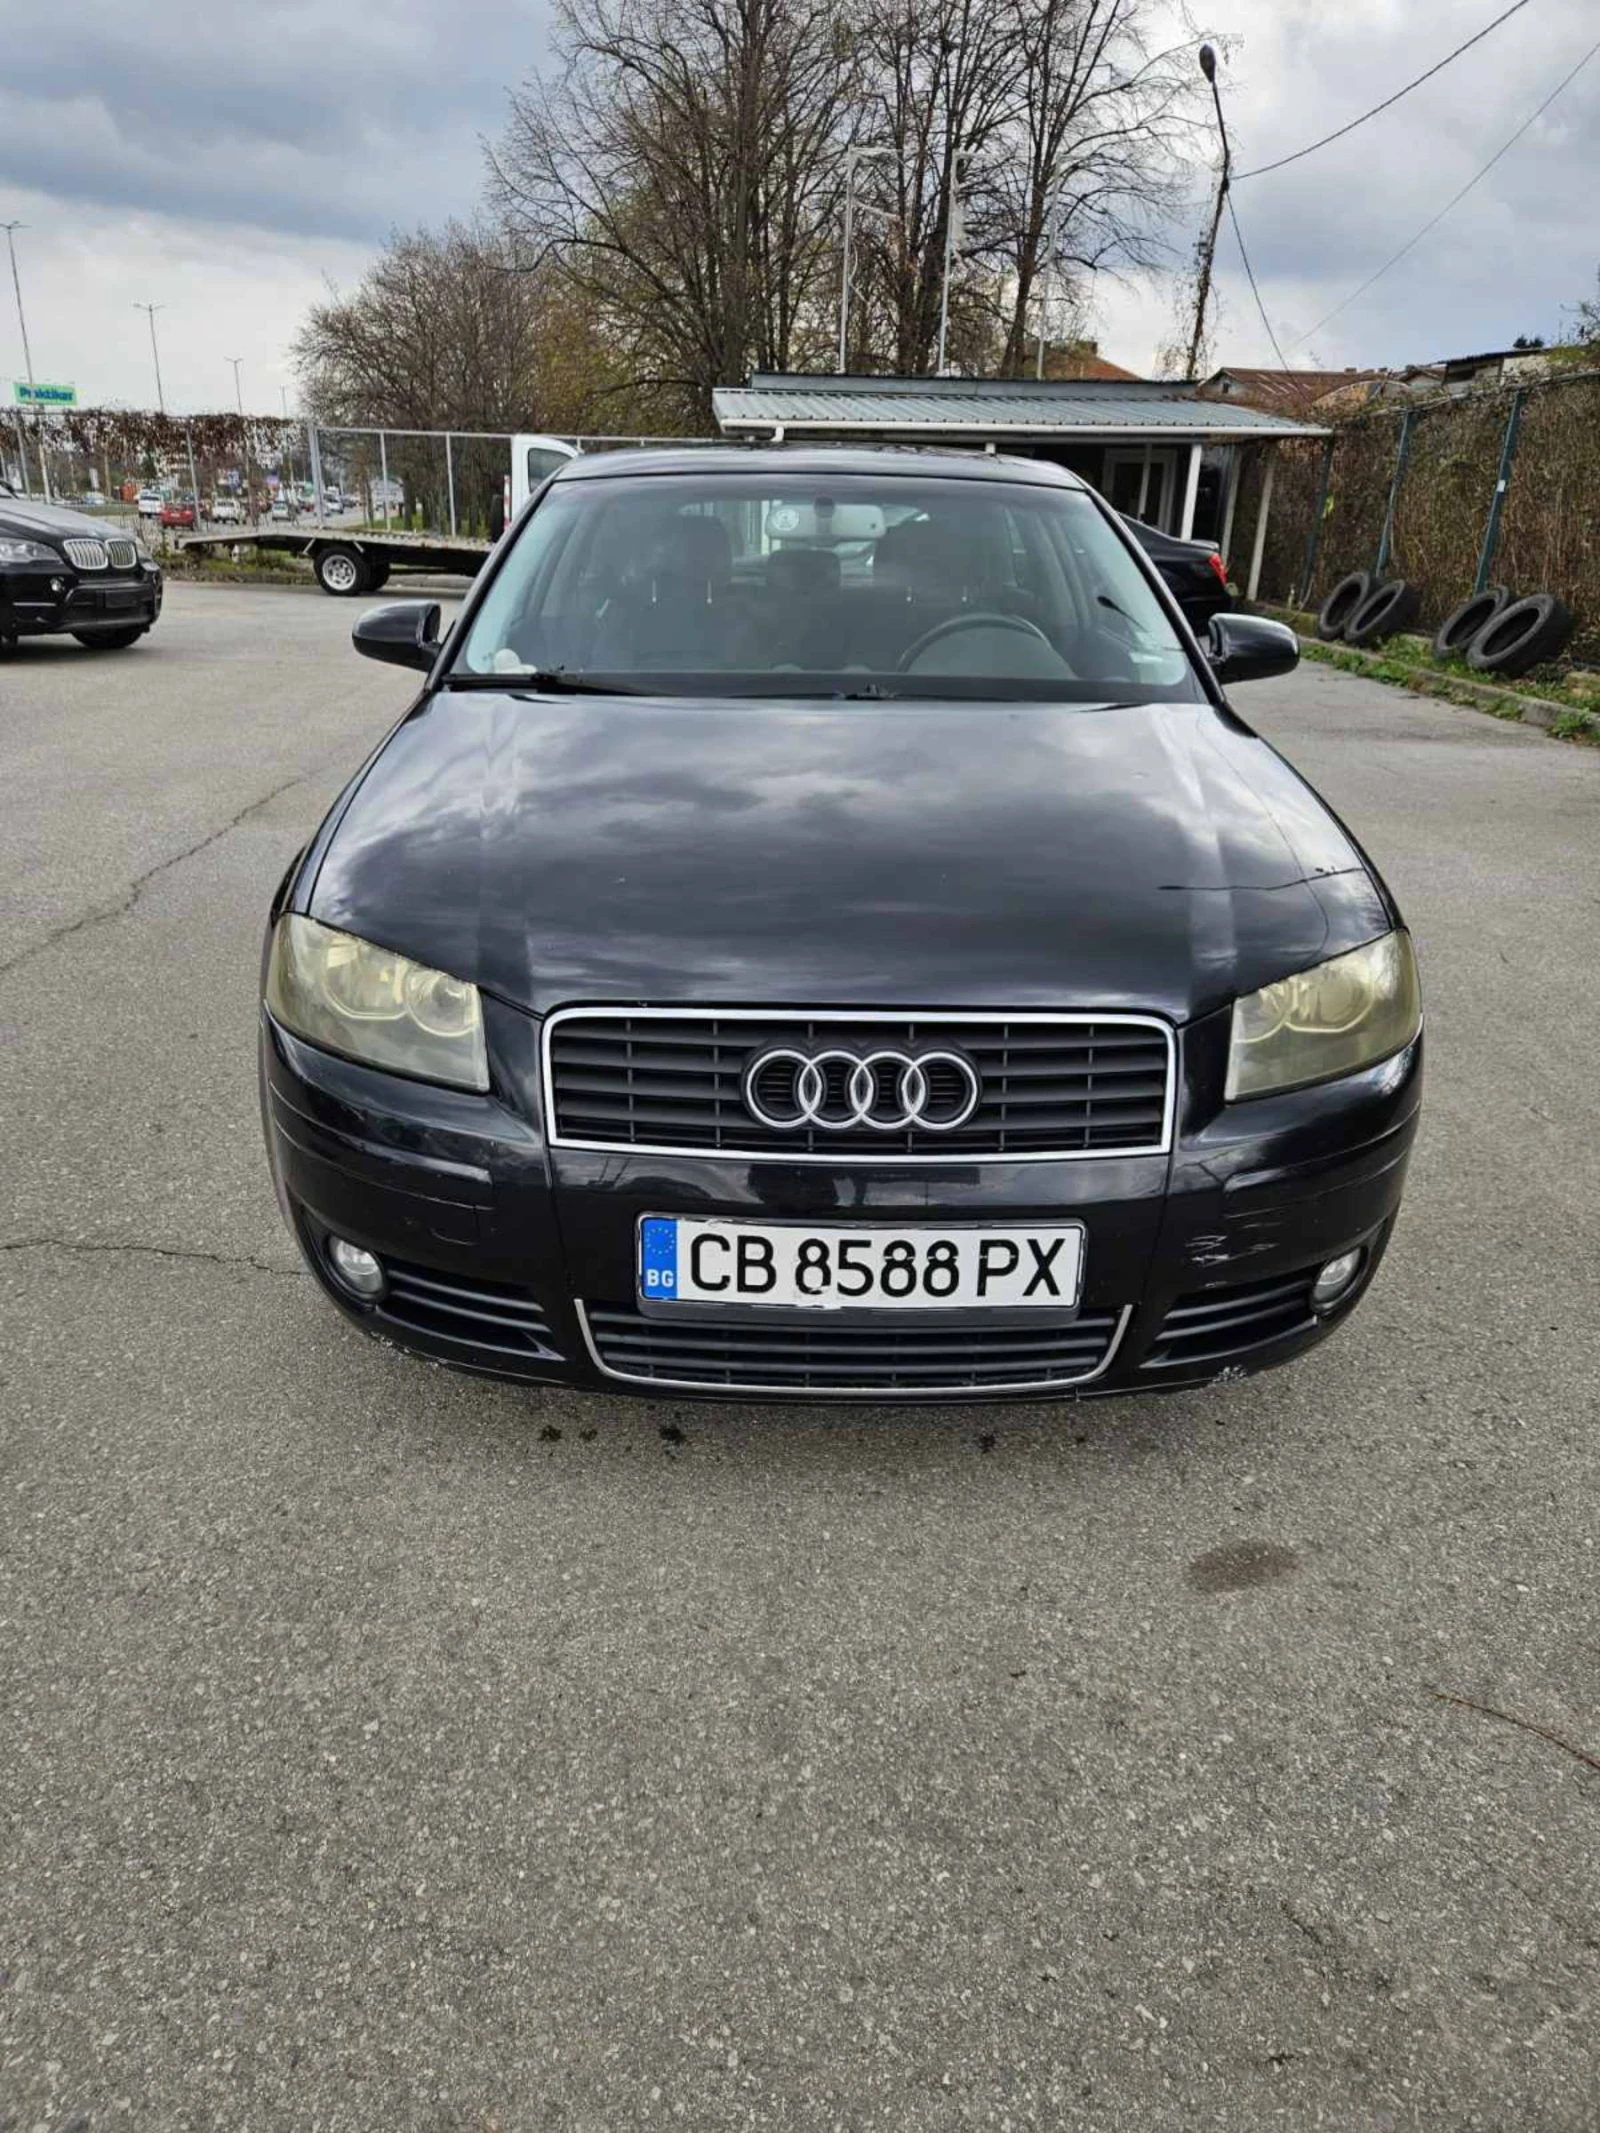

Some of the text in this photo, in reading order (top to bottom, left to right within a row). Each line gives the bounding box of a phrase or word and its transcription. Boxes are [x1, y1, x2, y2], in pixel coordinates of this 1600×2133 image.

[647, 1268, 674, 1287] BG
[690, 1233, 1067, 1298] CB 8588 PX
